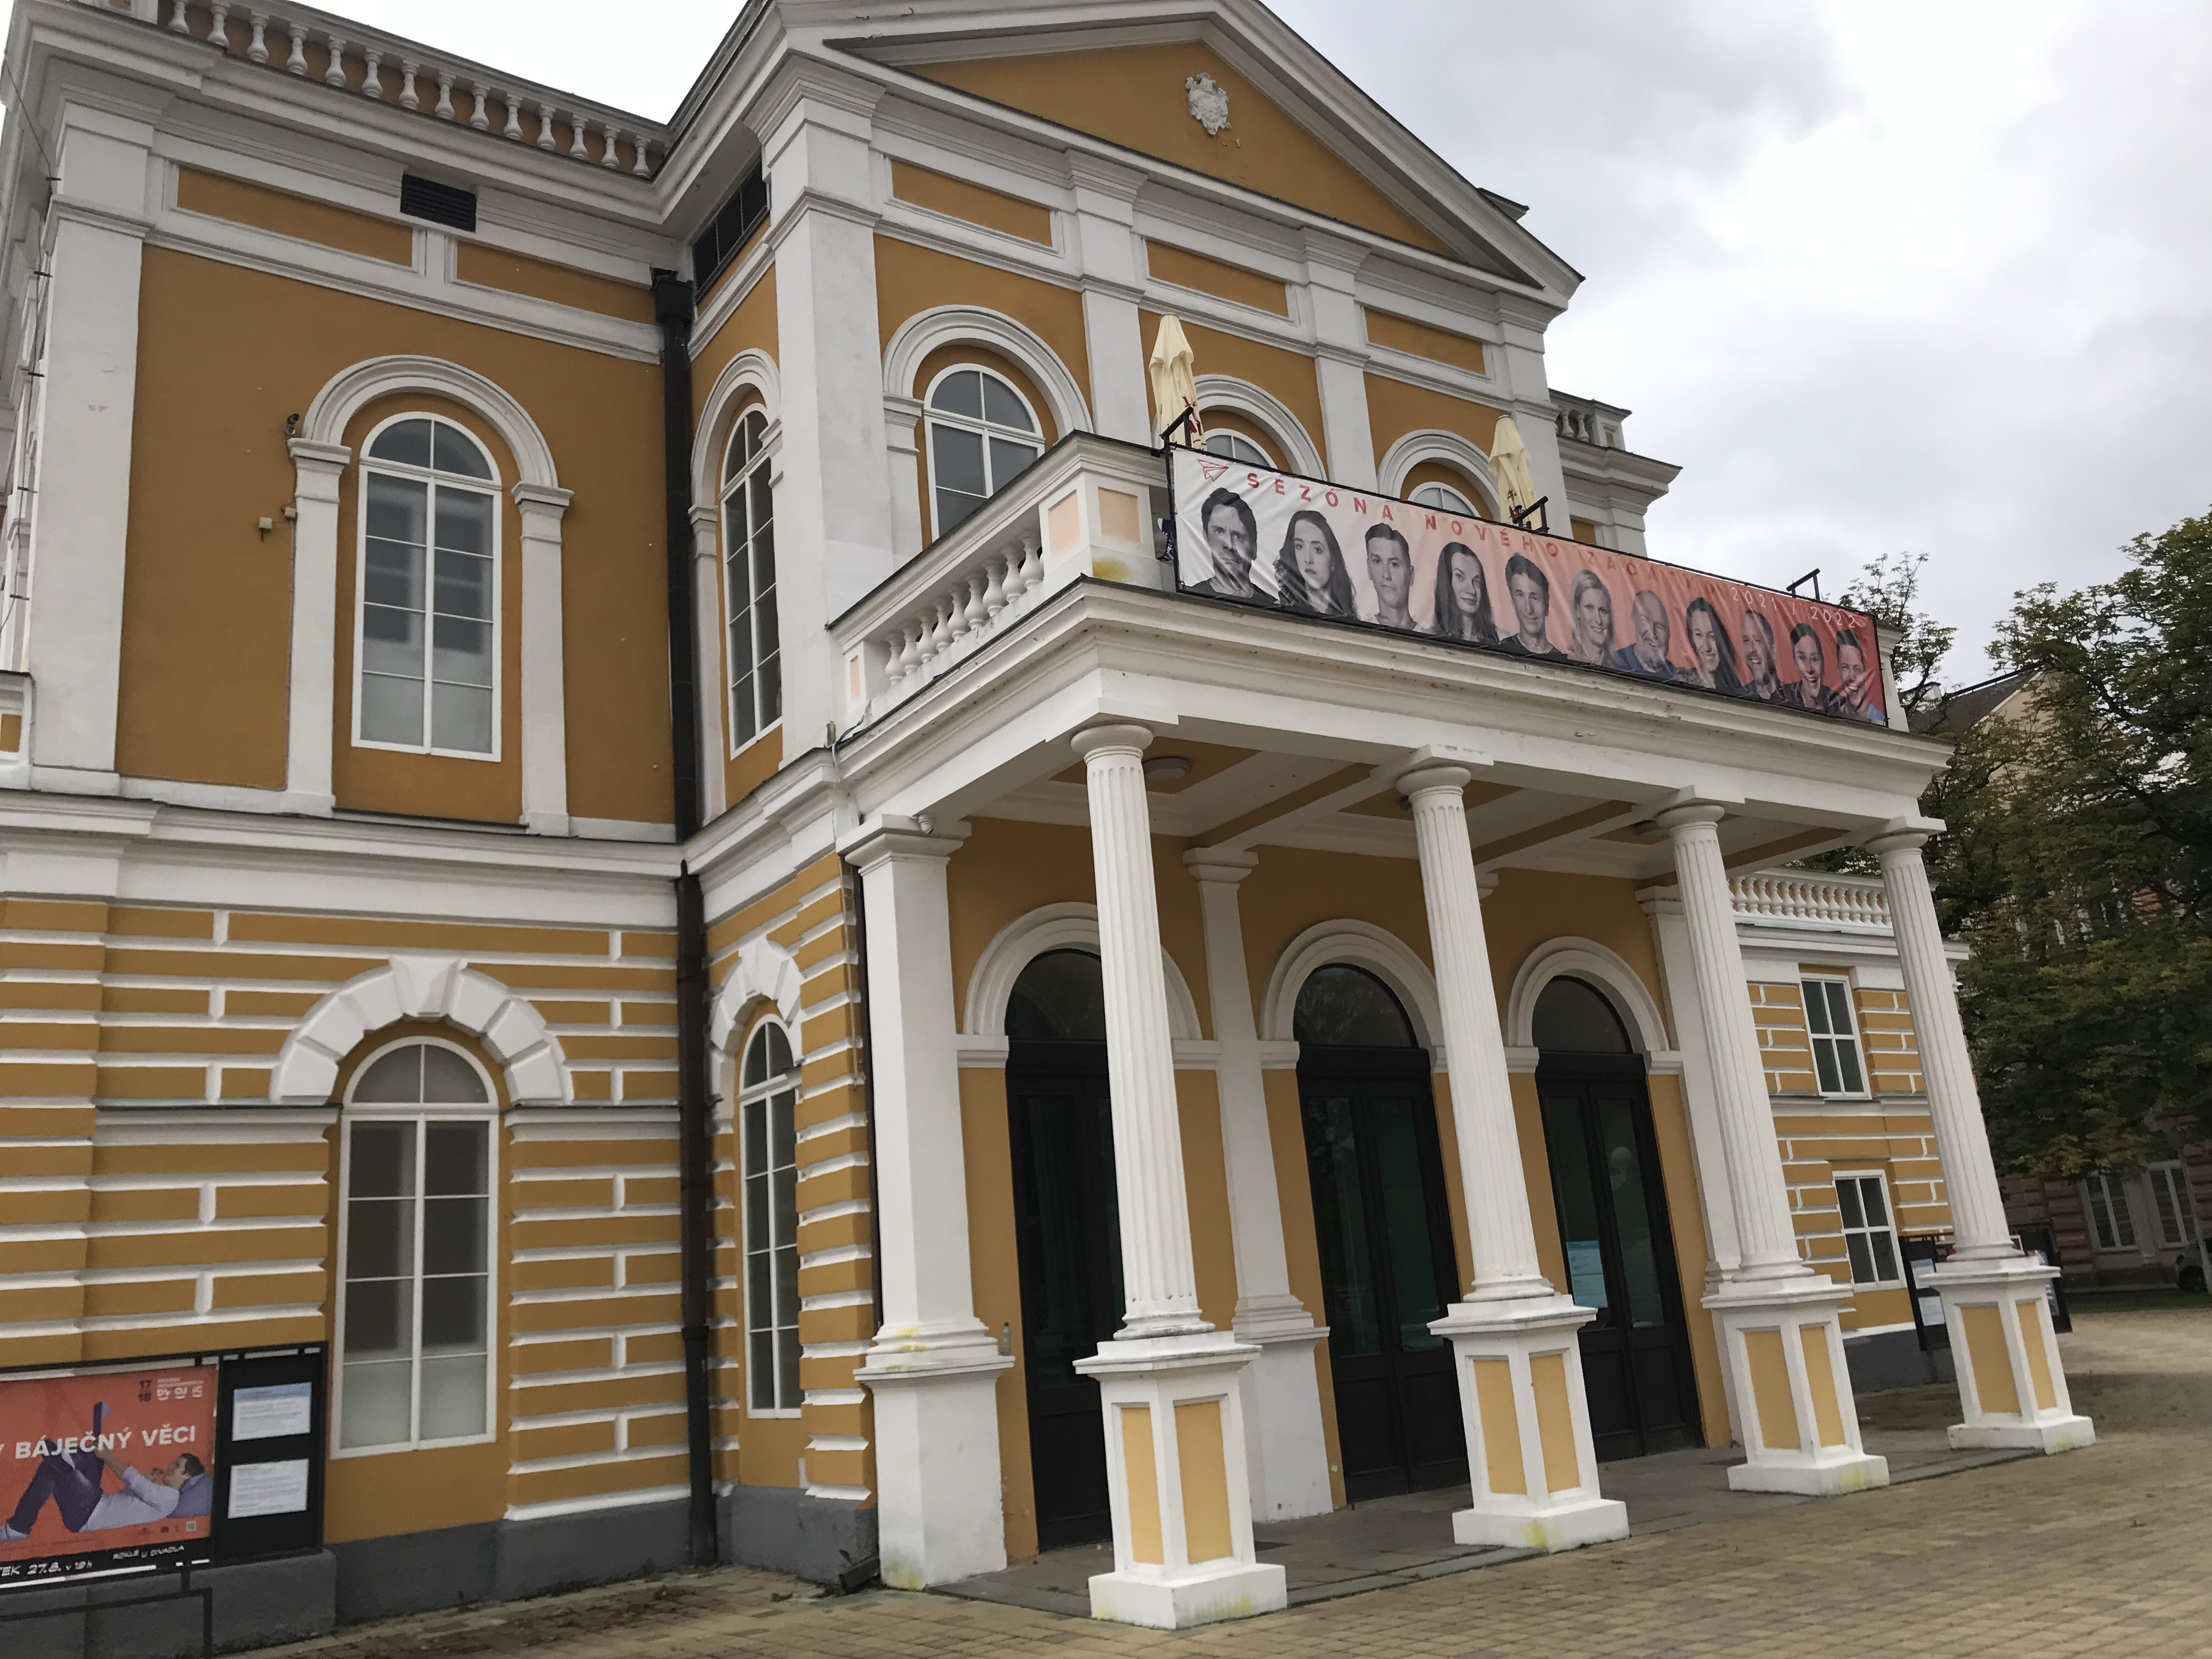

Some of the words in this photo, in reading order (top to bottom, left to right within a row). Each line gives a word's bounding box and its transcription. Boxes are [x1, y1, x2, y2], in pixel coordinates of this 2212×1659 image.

[1246, 472, 1394, 521] SEZÓNA
[1425, 514, 1559, 557] NOVÉHO
[1730, 586, 1778, 611] 2021
[1810, 606, 1858, 629] 2022
[15, 1426, 132, 1460] BÁJEČNÝ
[141, 1423, 195, 1447] VĚCI
